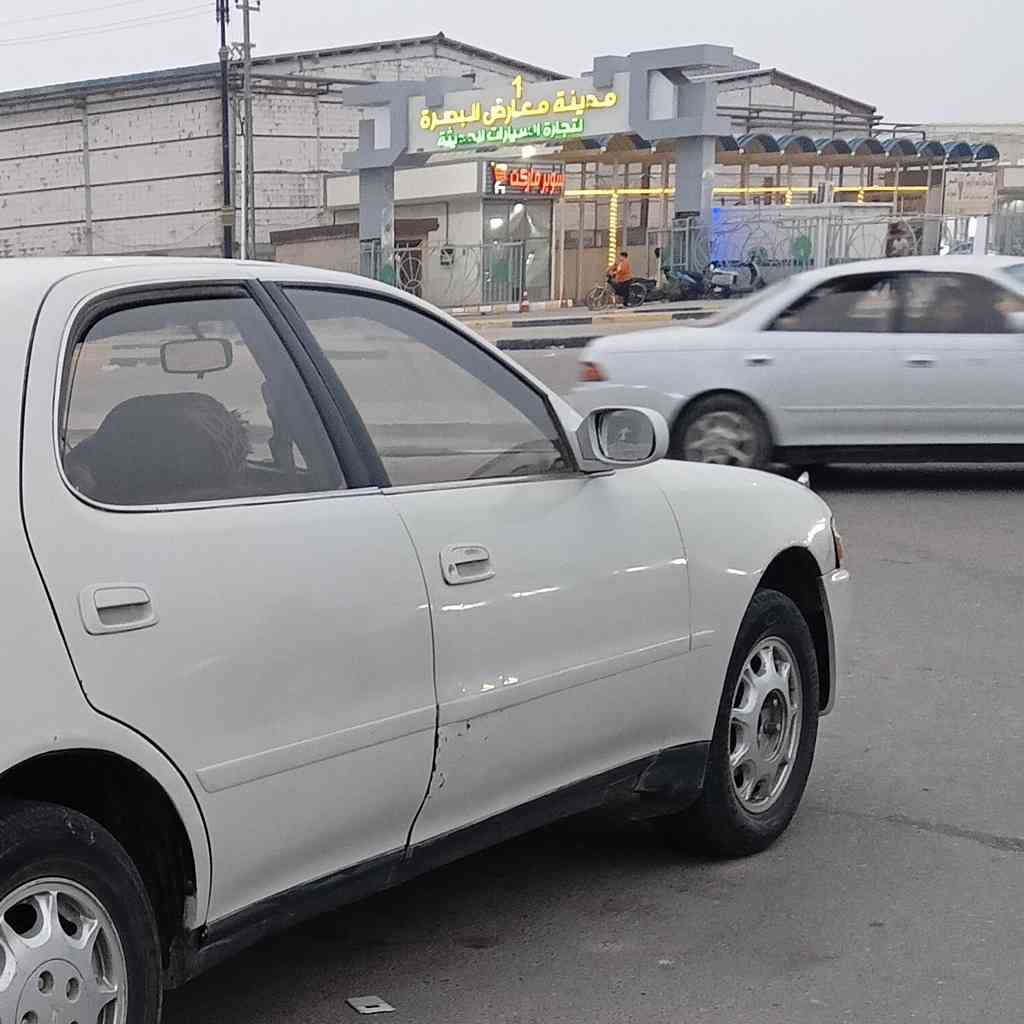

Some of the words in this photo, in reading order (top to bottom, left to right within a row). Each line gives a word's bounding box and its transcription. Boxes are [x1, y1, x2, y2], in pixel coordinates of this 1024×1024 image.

[483, 97, 550, 125] معارض
[553, 89, 618, 115] مدينة
[420, 102, 481, 131] البصرة
[542, 118, 584, 139] لتجارة
[436, 127, 486, 149] الحديثة
[486, 123, 541, 144] السيارات
[510, 167, 541, 192] ماركت
[540, 169, 565, 194] سوبر
